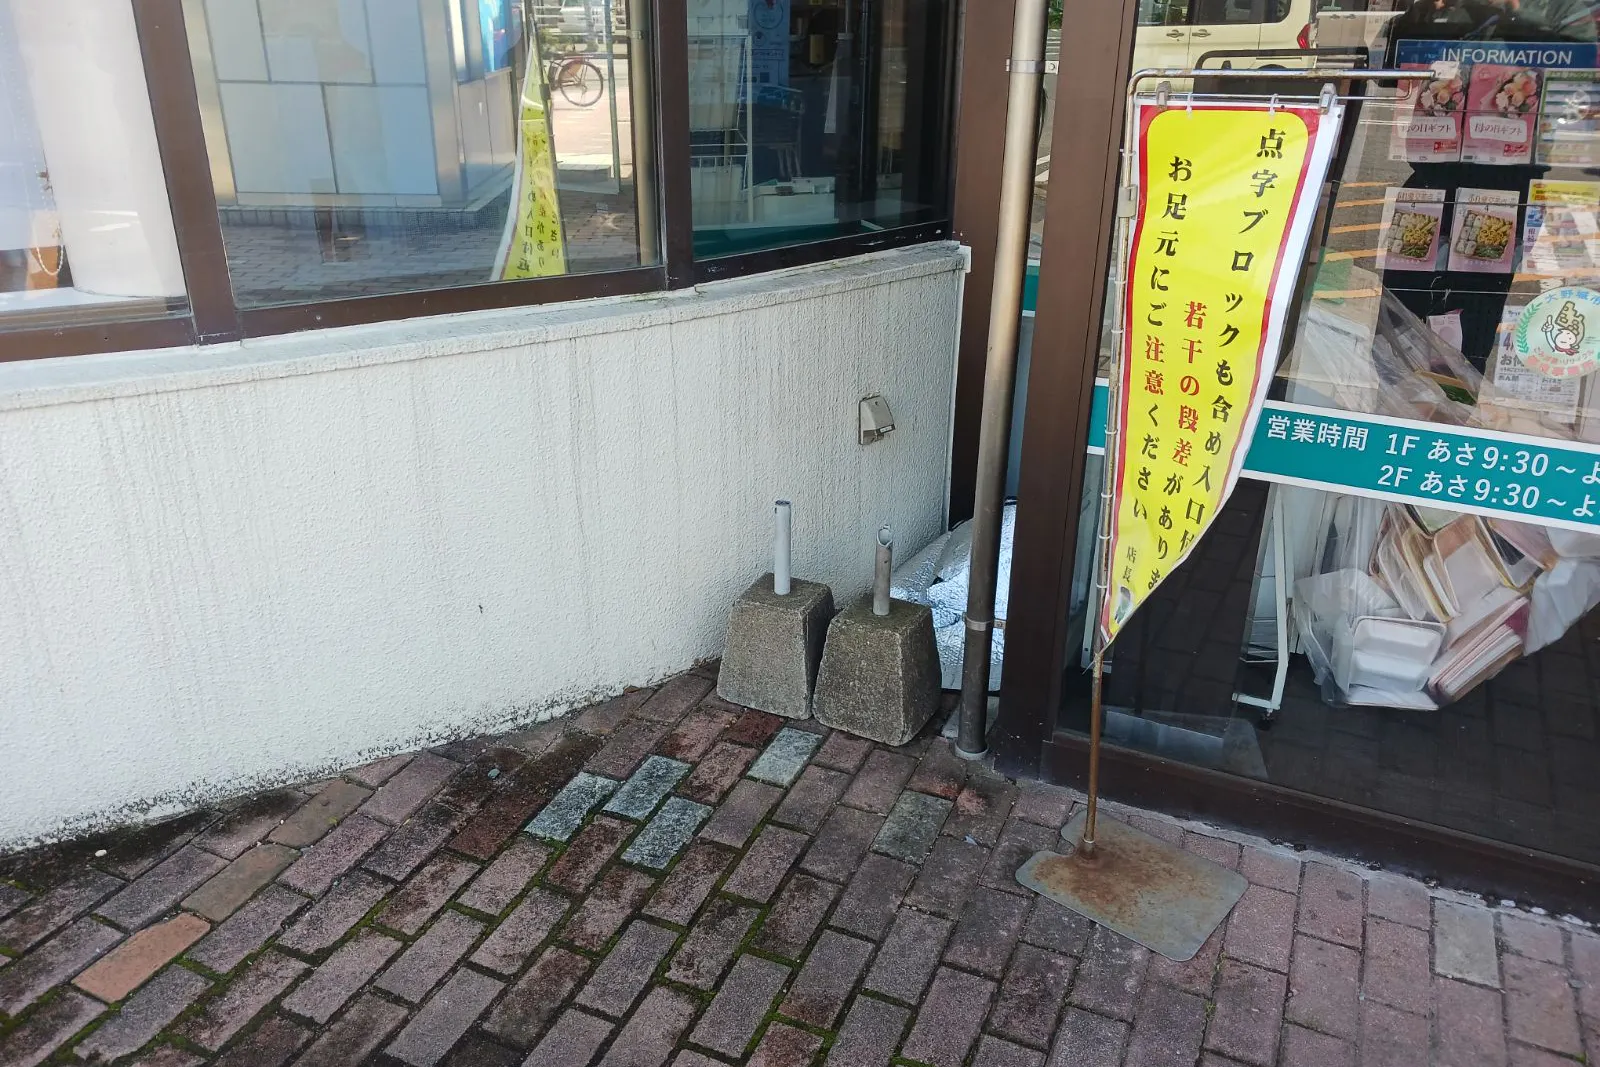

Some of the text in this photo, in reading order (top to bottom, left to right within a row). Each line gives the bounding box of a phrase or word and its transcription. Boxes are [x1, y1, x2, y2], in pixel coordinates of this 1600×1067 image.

[1442, 48, 1573, 66] INFORMATION
[1133, 156, 1192, 520] お足元にご注意ください
[1267, 414, 1369, 452] 営業時間
[1385, 433, 1420, 457] 1F
[1377, 464, 1600, 518] 2F あさ9:30～よ
